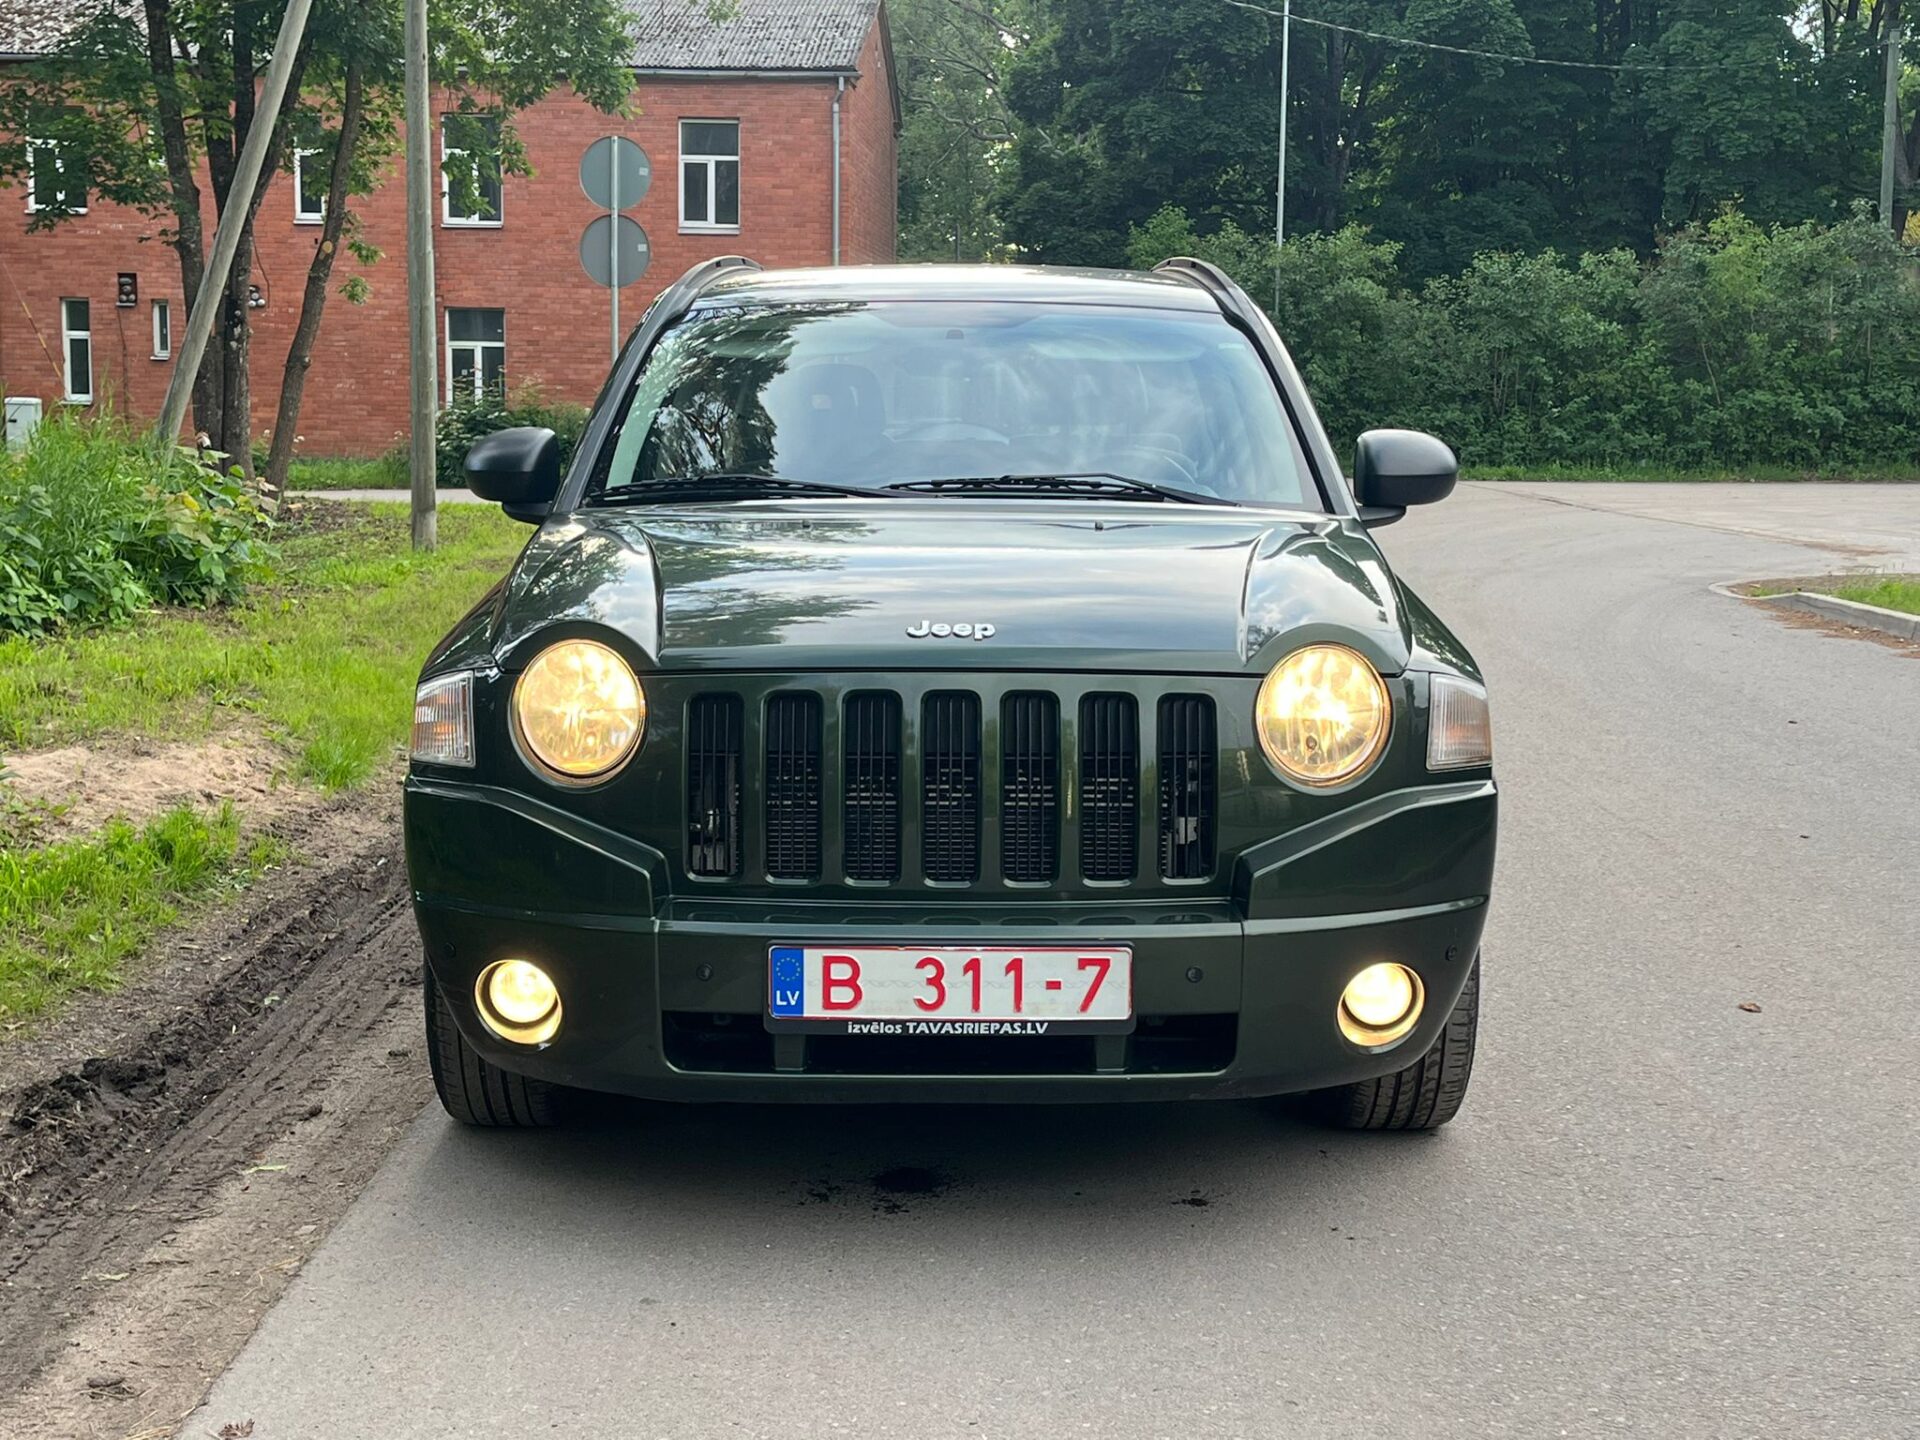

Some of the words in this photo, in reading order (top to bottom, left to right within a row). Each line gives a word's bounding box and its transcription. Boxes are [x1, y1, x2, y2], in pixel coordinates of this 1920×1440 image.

[906, 620, 996, 641] Jeep
[822, 955, 863, 1011] B
[913, 956, 1111, 1013] 311-7
[776, 990, 800, 1006] LV
[906, 1022, 1049, 1035] TAVASRIEPAS.LV
